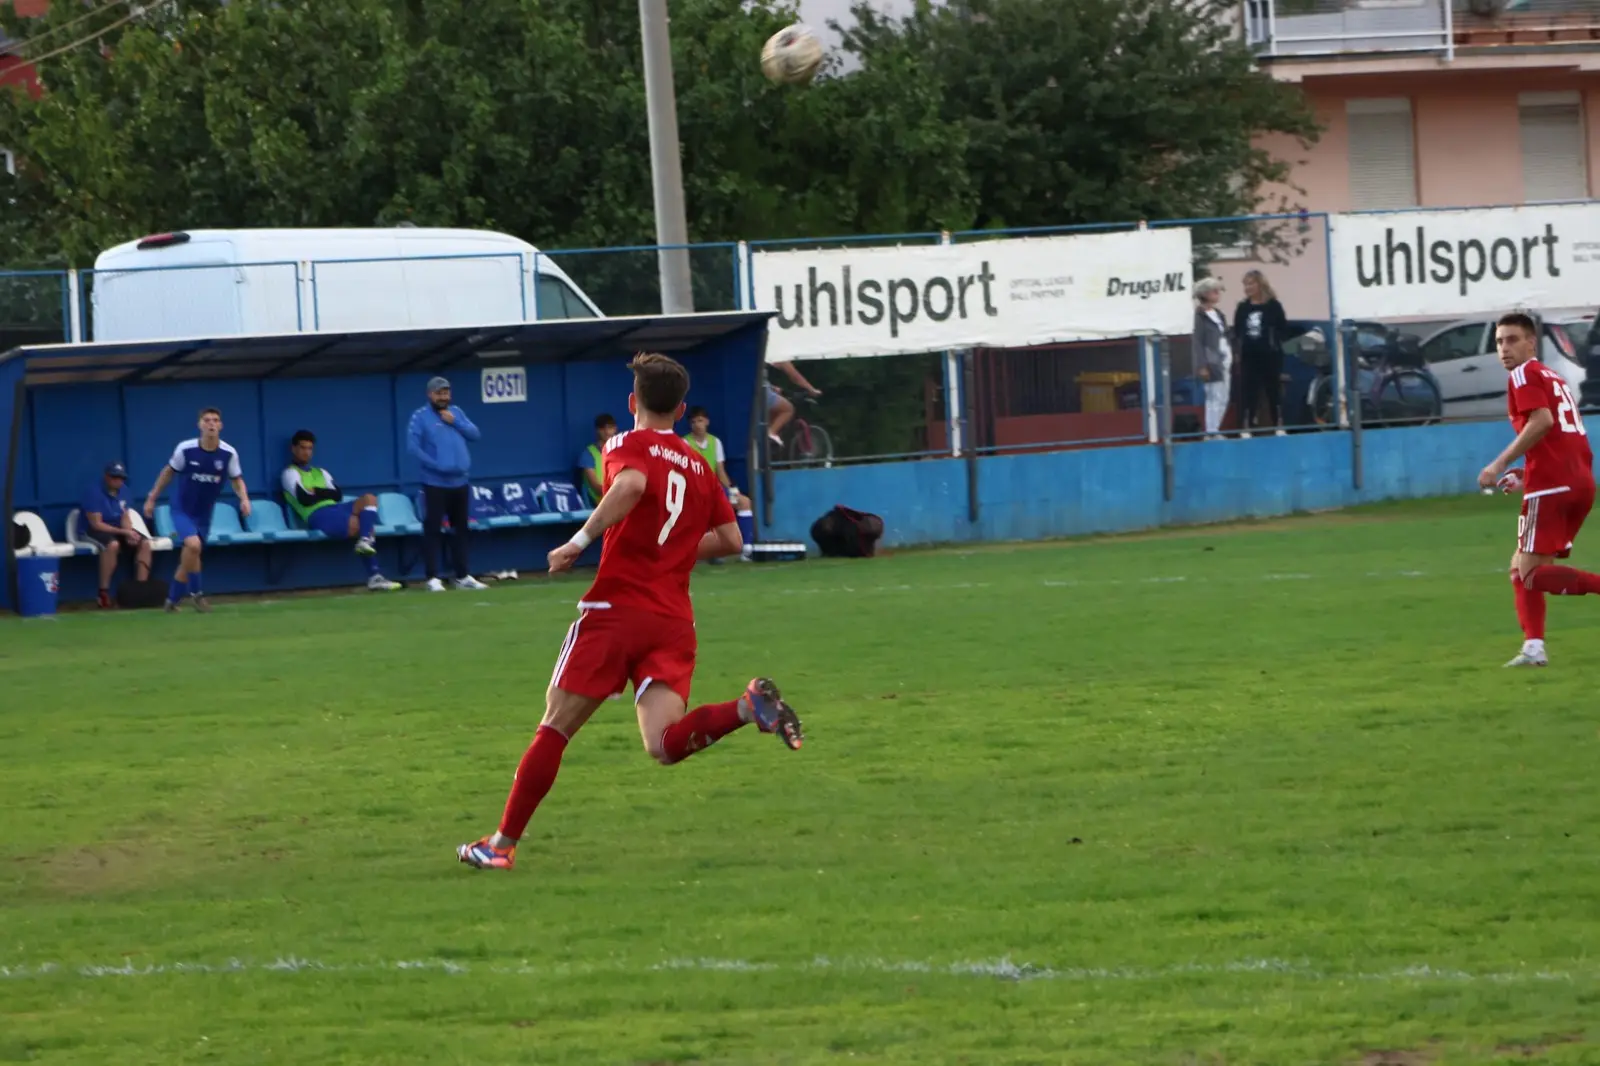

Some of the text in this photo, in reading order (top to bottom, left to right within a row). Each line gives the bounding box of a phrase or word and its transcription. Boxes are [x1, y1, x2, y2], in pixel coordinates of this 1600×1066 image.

[1106, 272, 1186, 299] Druga NL
[1355, 223, 1561, 297] uhlsport
[774, 260, 998, 338] uhlsport
[484, 373, 525, 398] GOSTI
[657, 469, 687, 546] 9
